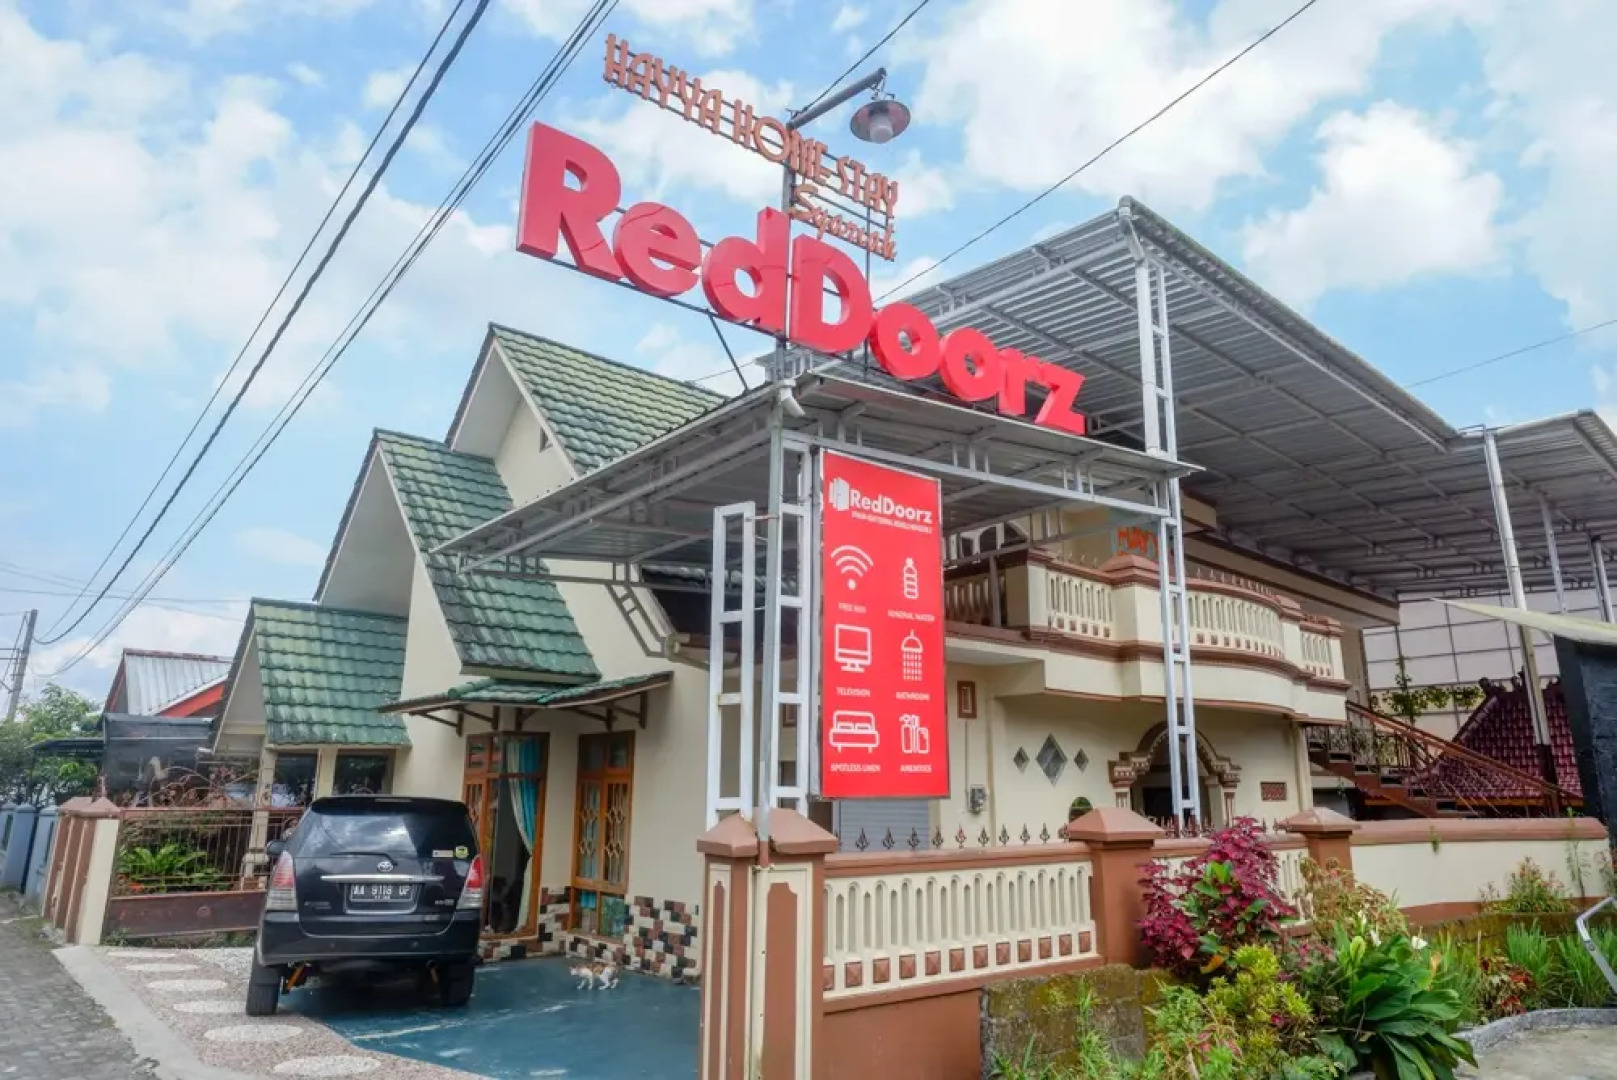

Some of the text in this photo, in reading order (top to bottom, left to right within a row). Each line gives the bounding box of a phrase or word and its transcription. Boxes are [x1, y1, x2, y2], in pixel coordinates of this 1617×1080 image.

[603, 33, 898, 218] HAYYA HOME STAY
[516, 121, 1086, 435] RedDoorz
[850, 489, 932, 525] RedDoorz
[836, 686, 871, 697] TELEVISION
[830, 763, 862, 772] SPOTLESS
